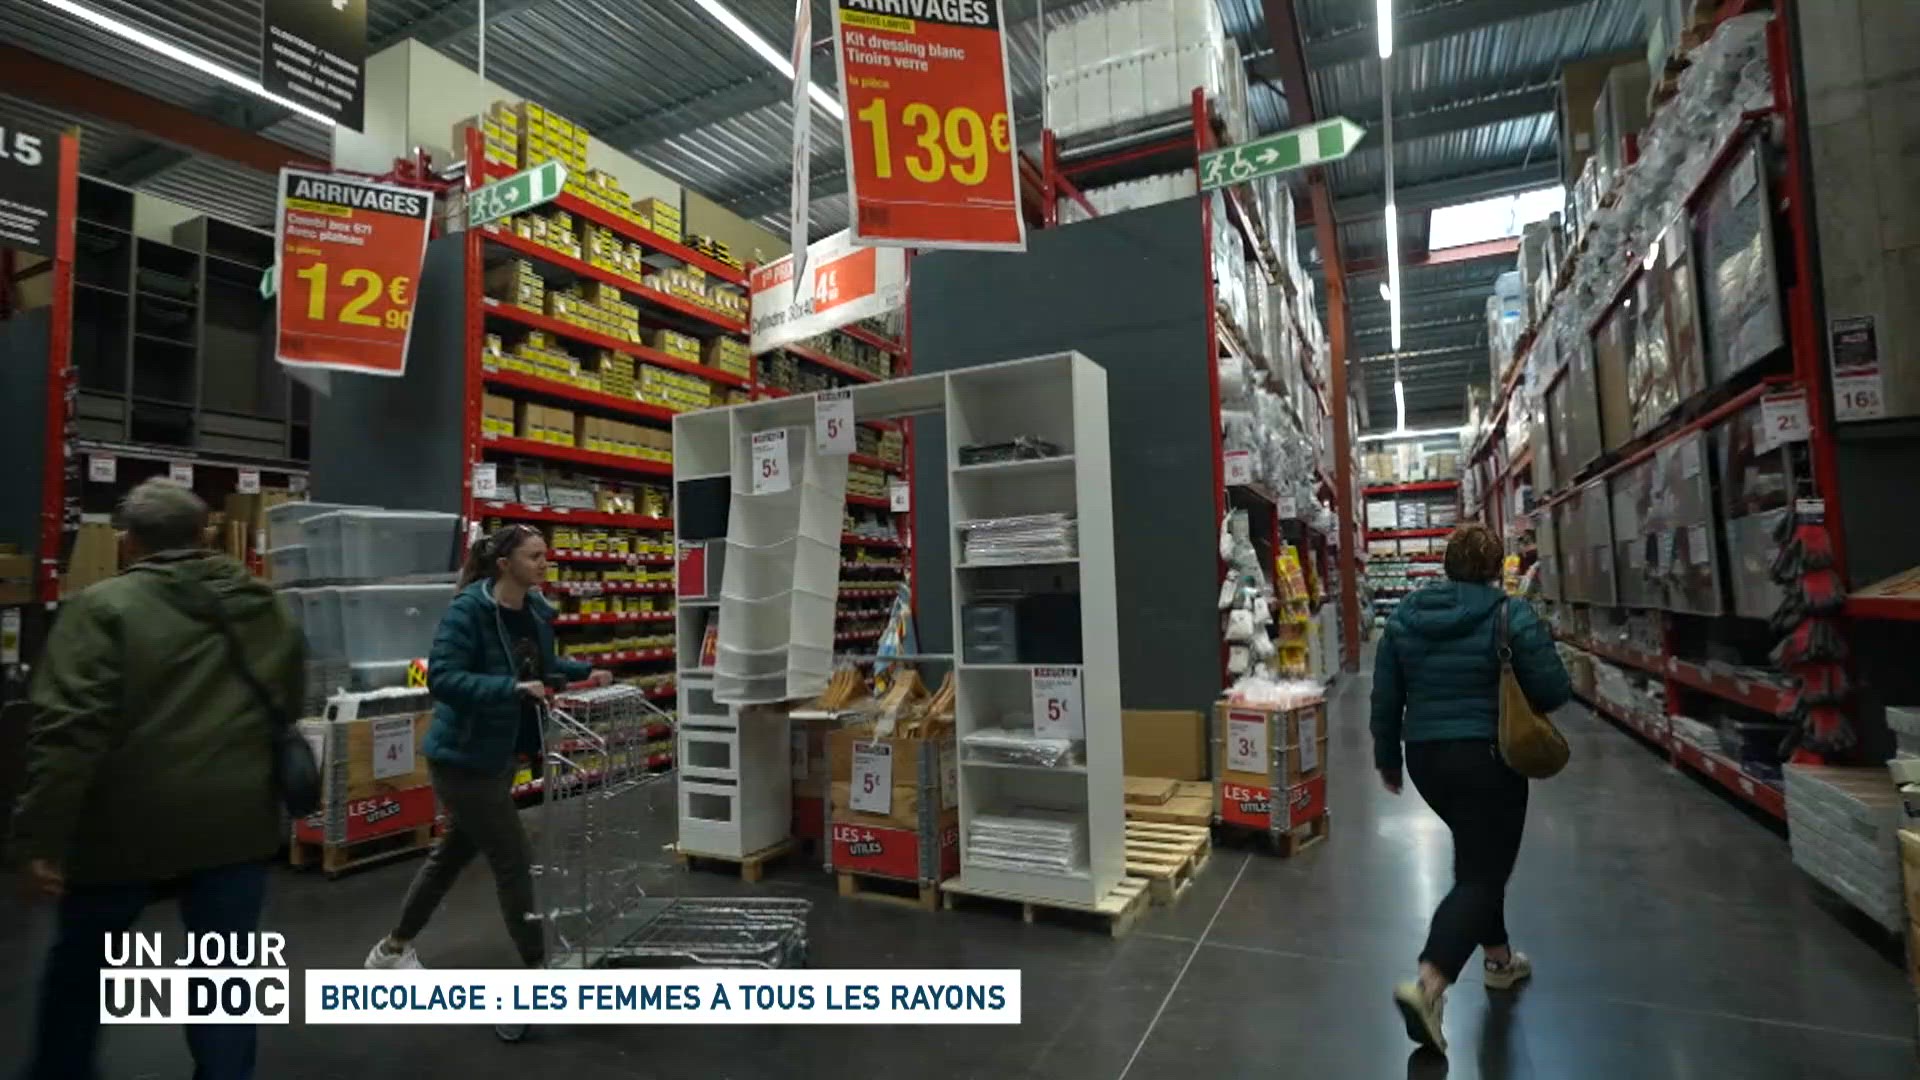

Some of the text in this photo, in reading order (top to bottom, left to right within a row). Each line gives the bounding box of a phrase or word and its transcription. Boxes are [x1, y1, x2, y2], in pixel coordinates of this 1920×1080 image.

[845, 31, 965, 61] Kit dressing blanc
[848, 47, 929, 72] Tiroirs verre
[295, 179, 420, 216] ARRIVAGES
[1224, 784, 1250, 801] LES
[347, 800, 377, 817] LES
[834, 826, 859, 843] LES
[850, 841, 882, 855] UTILES
